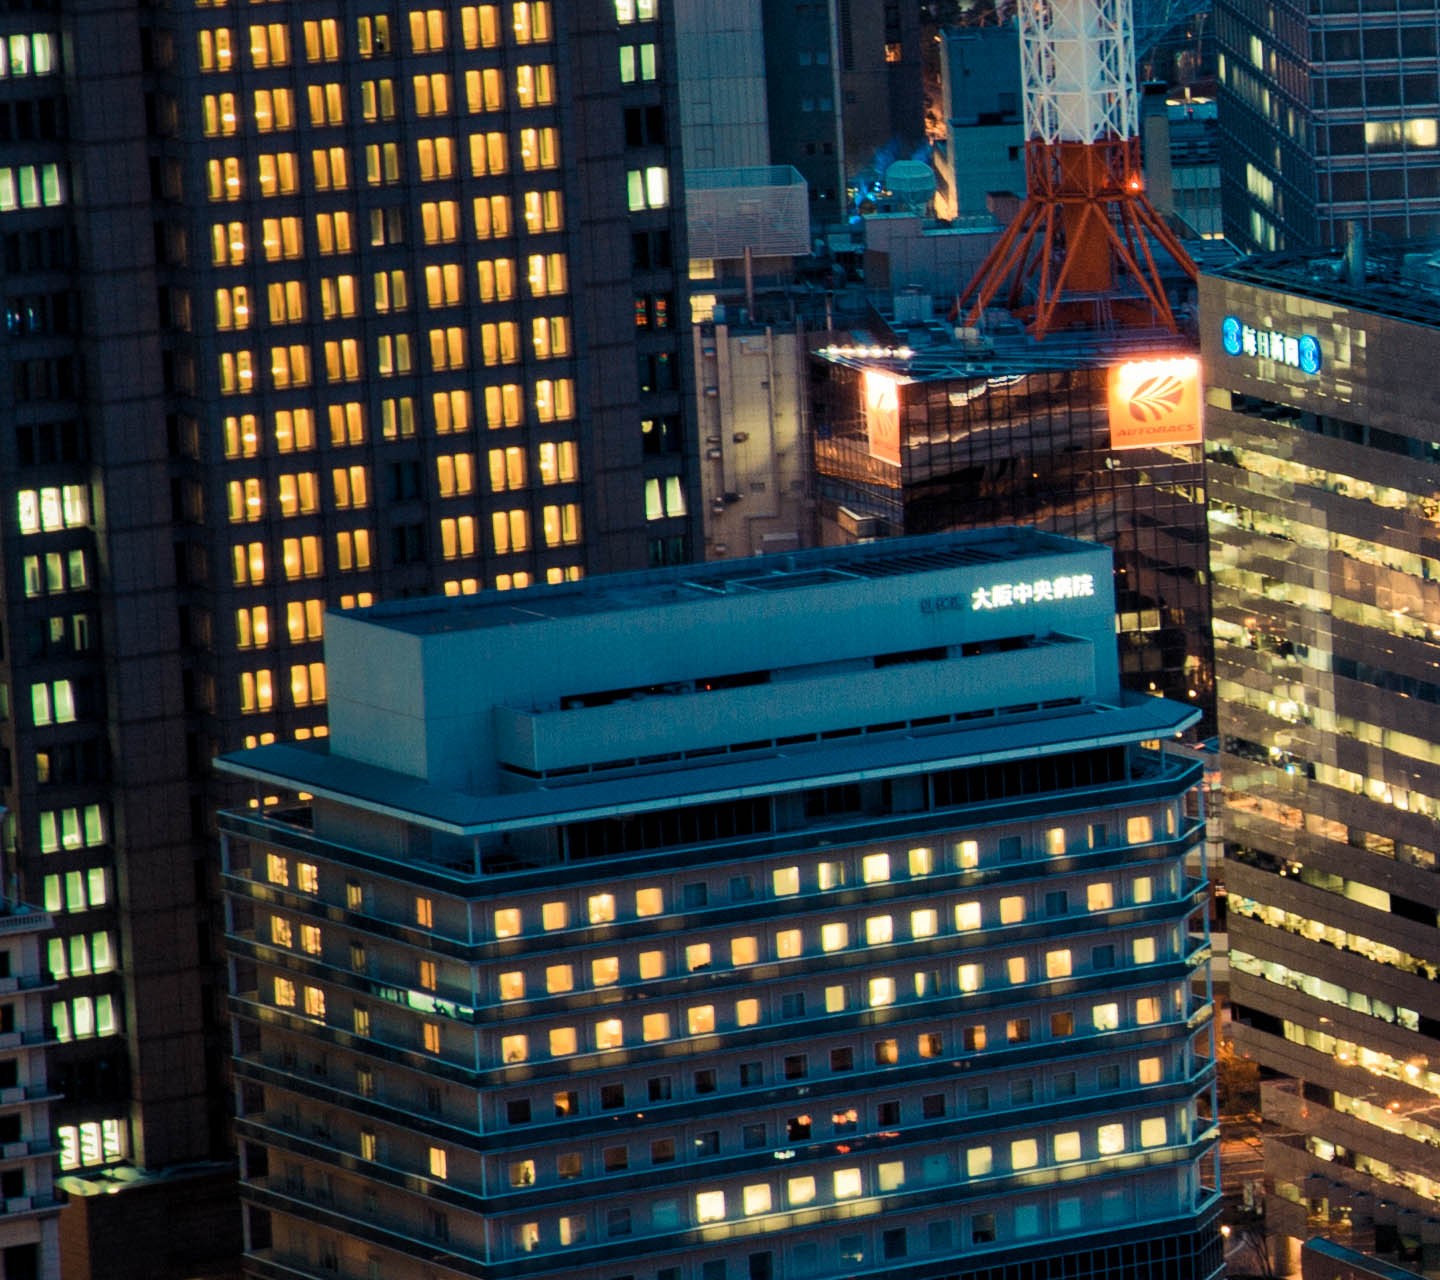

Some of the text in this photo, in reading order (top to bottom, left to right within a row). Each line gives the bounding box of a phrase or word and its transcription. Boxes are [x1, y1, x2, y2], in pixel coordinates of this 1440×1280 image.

[1241, 324, 1300, 368] 毎日新聞
[1116, 422, 1196, 438] AUTOBACS
[971, 573, 1095, 611] 大阪中央病院
